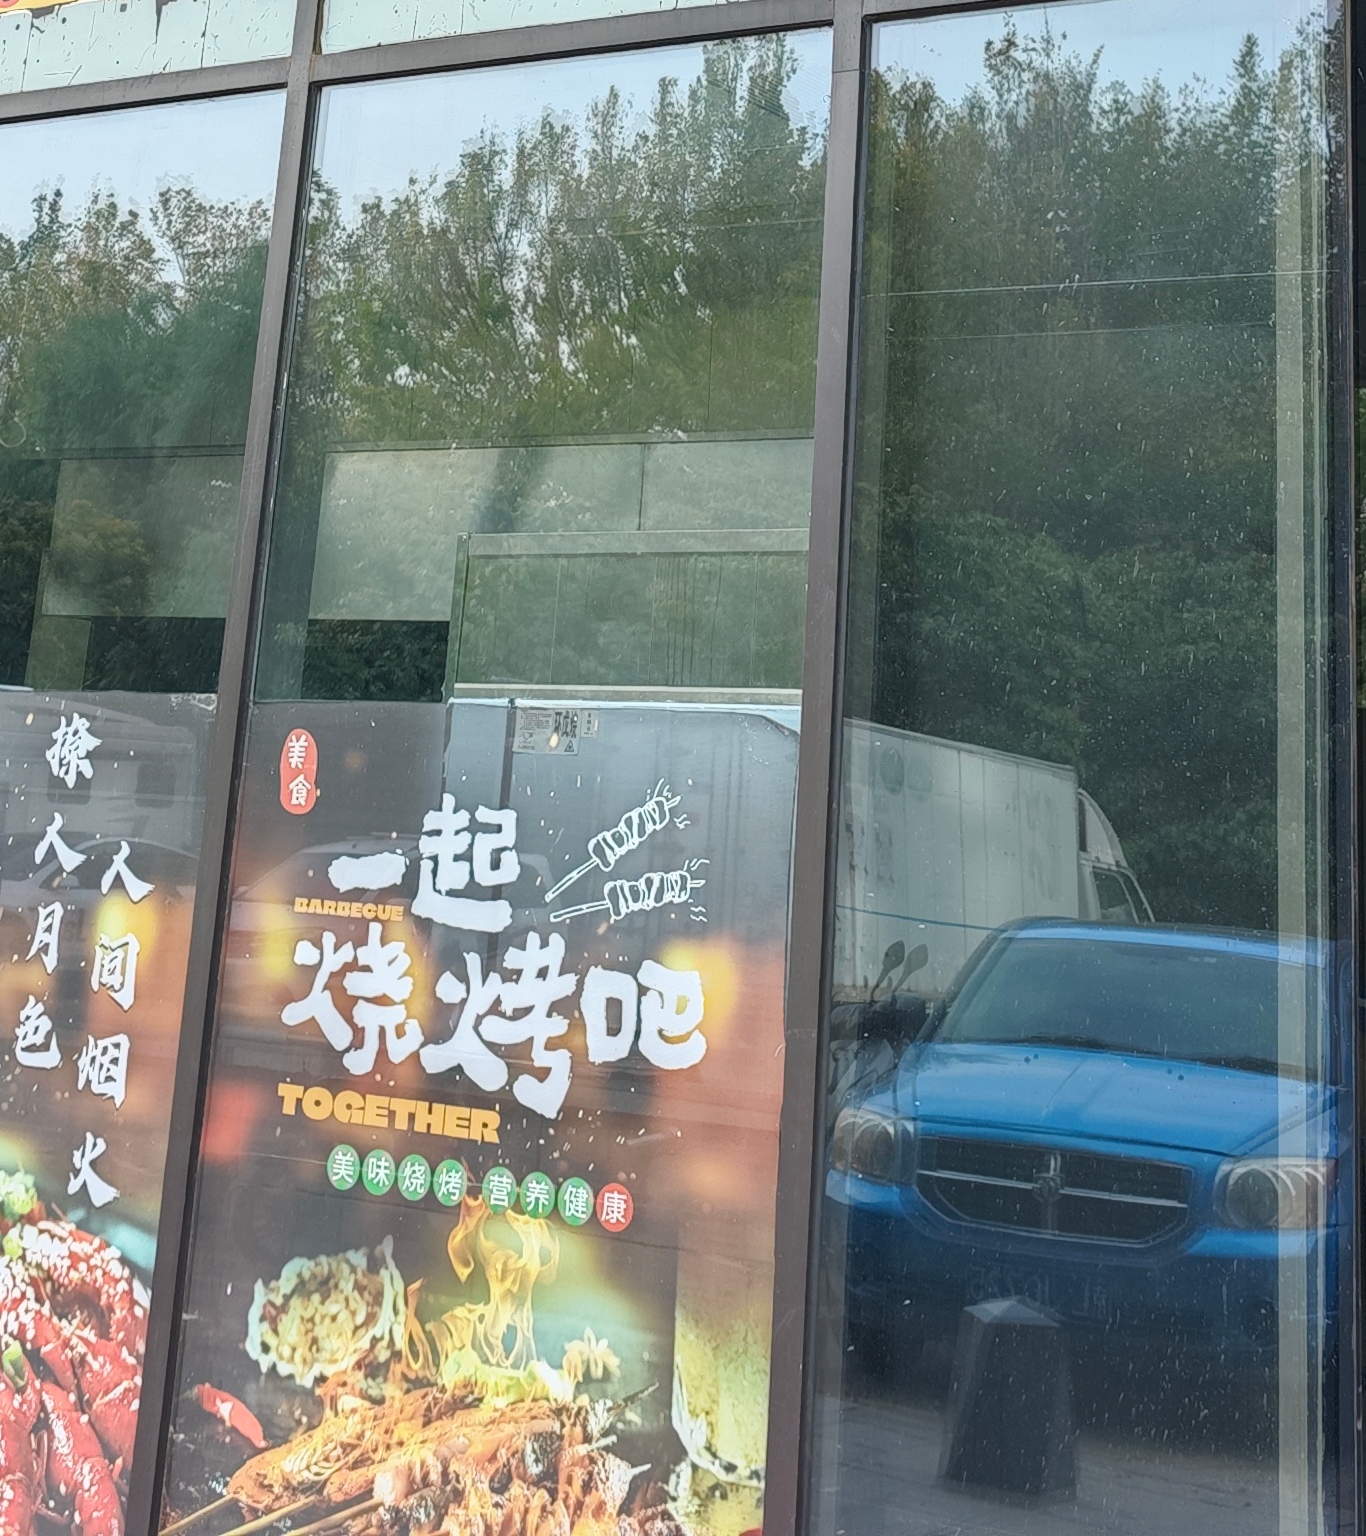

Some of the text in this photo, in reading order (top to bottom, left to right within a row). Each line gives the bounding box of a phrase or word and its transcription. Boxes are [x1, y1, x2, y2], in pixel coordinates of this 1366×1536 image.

[286, 733, 313, 807] 美食
[14, 713, 103, 1071] 撩人月色
[328, 793, 521, 933] 一起
[293, 897, 404, 922] BARBECUE
[67, 840, 156, 1208] 人间烟火
[281, 922, 707, 1119] 烧烤吧
[277, 1083, 501, 1143] TOGETHER
[331, 1150, 465, 1205] 美味烧烤
[486, 1172, 631, 1227] 营养健康
